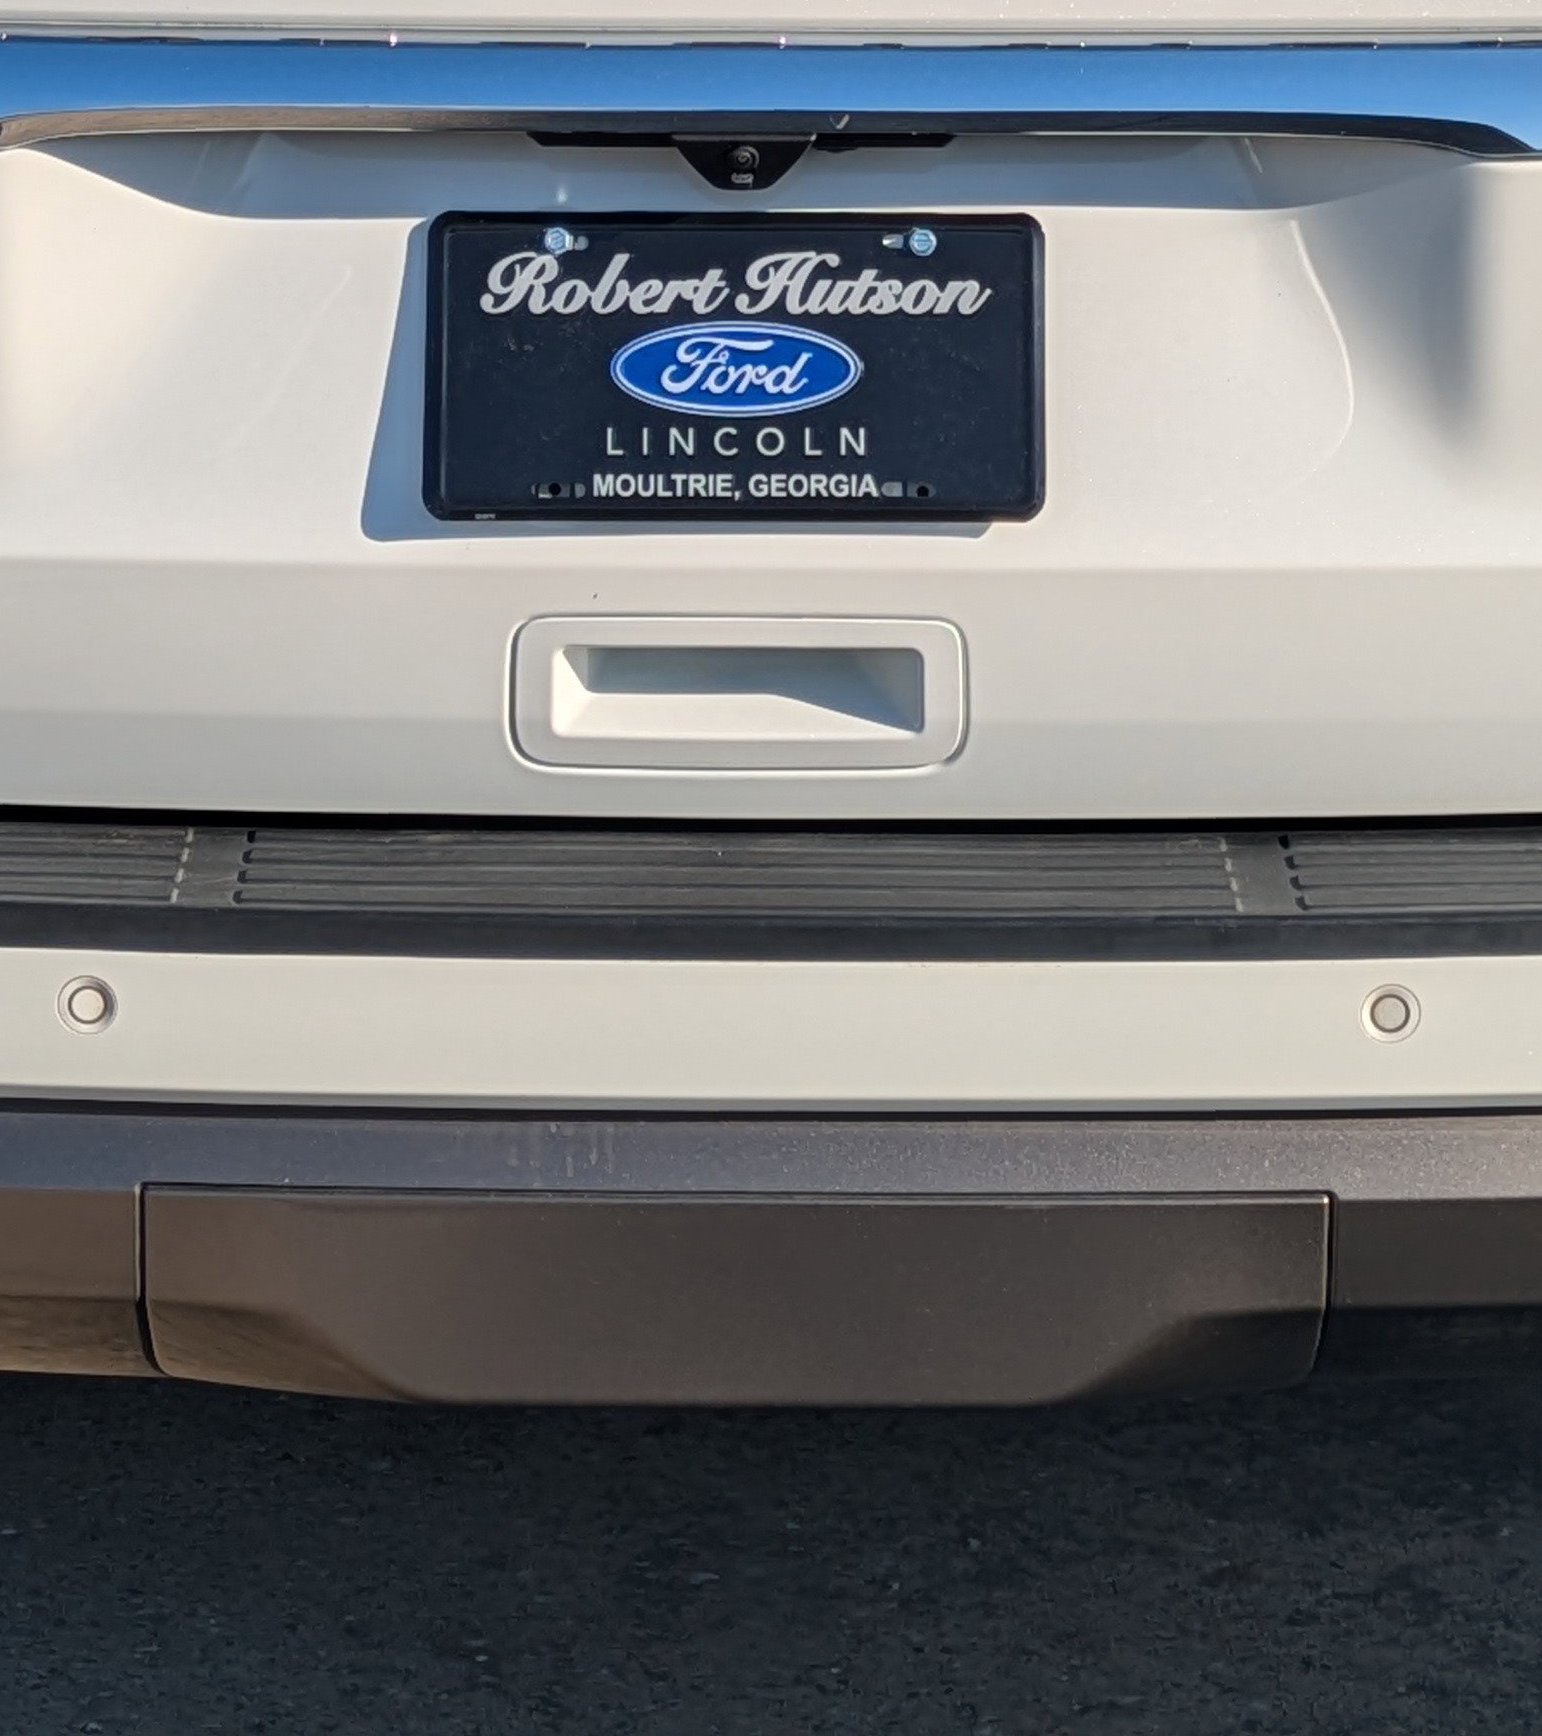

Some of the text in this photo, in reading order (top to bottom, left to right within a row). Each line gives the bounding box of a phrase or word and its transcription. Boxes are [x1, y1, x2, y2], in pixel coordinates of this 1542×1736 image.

[479, 250, 993, 316] Robert Hutson
[659, 335, 813, 397] Ford
[605, 426, 867, 457] LINCOLN
[592, 472, 880, 502] MOULTRIE, GEORGIA
